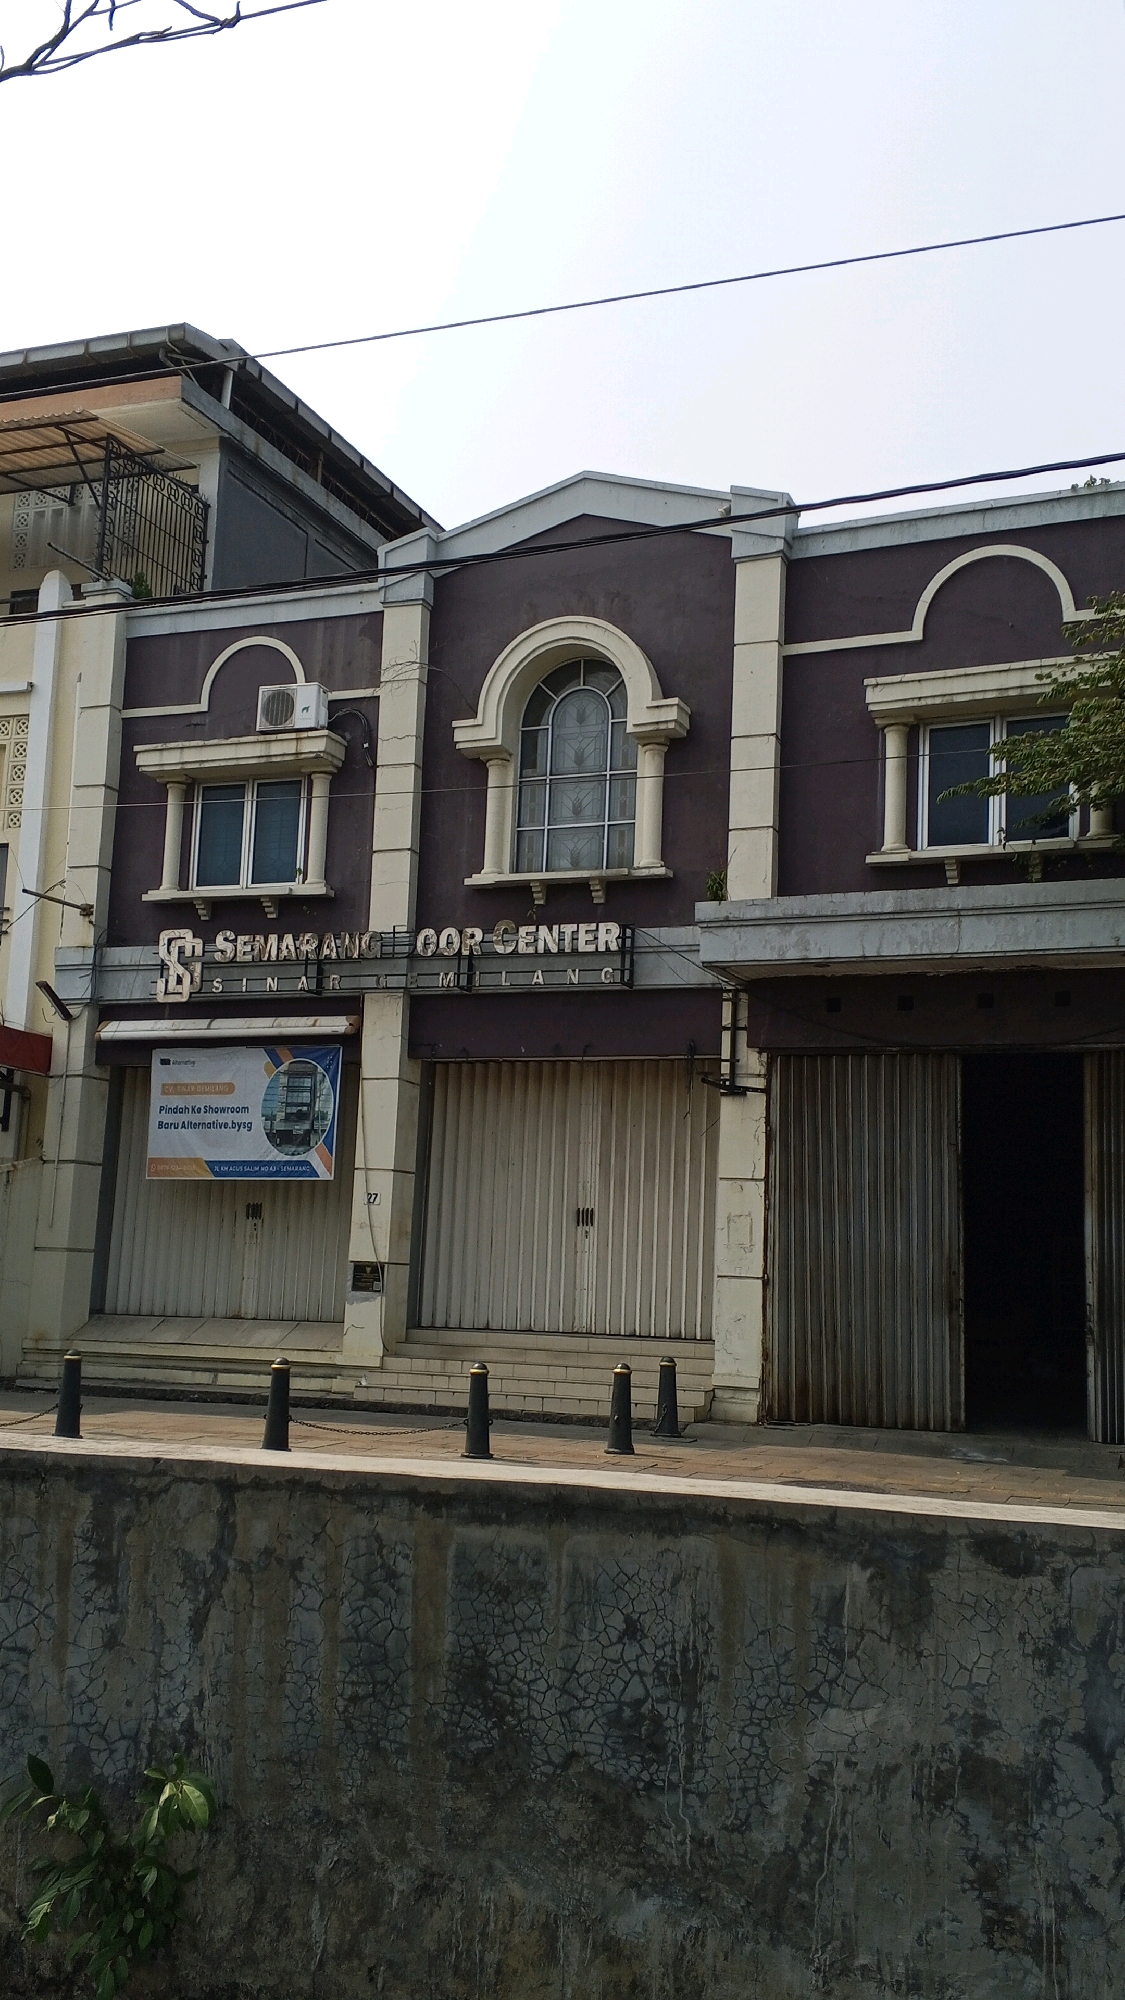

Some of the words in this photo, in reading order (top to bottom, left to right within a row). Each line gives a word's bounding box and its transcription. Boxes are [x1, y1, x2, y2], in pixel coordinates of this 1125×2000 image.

[213, 929, 382, 963] SEMARANG
[492, 919, 621, 954] CENTER
[212, 974, 341, 992] SINAR
[376, 967, 614, 989] GEMILANG
[159, 1105, 190, 1115] Pindah
[191, 1105, 202, 1115] Ke
[203, 1104, 250, 1114] Showroom
[157, 1120, 179, 1130] Baru
[180, 1119, 253, 1132] Alternative.bysg
[367, 1192, 379, 1204] 27
